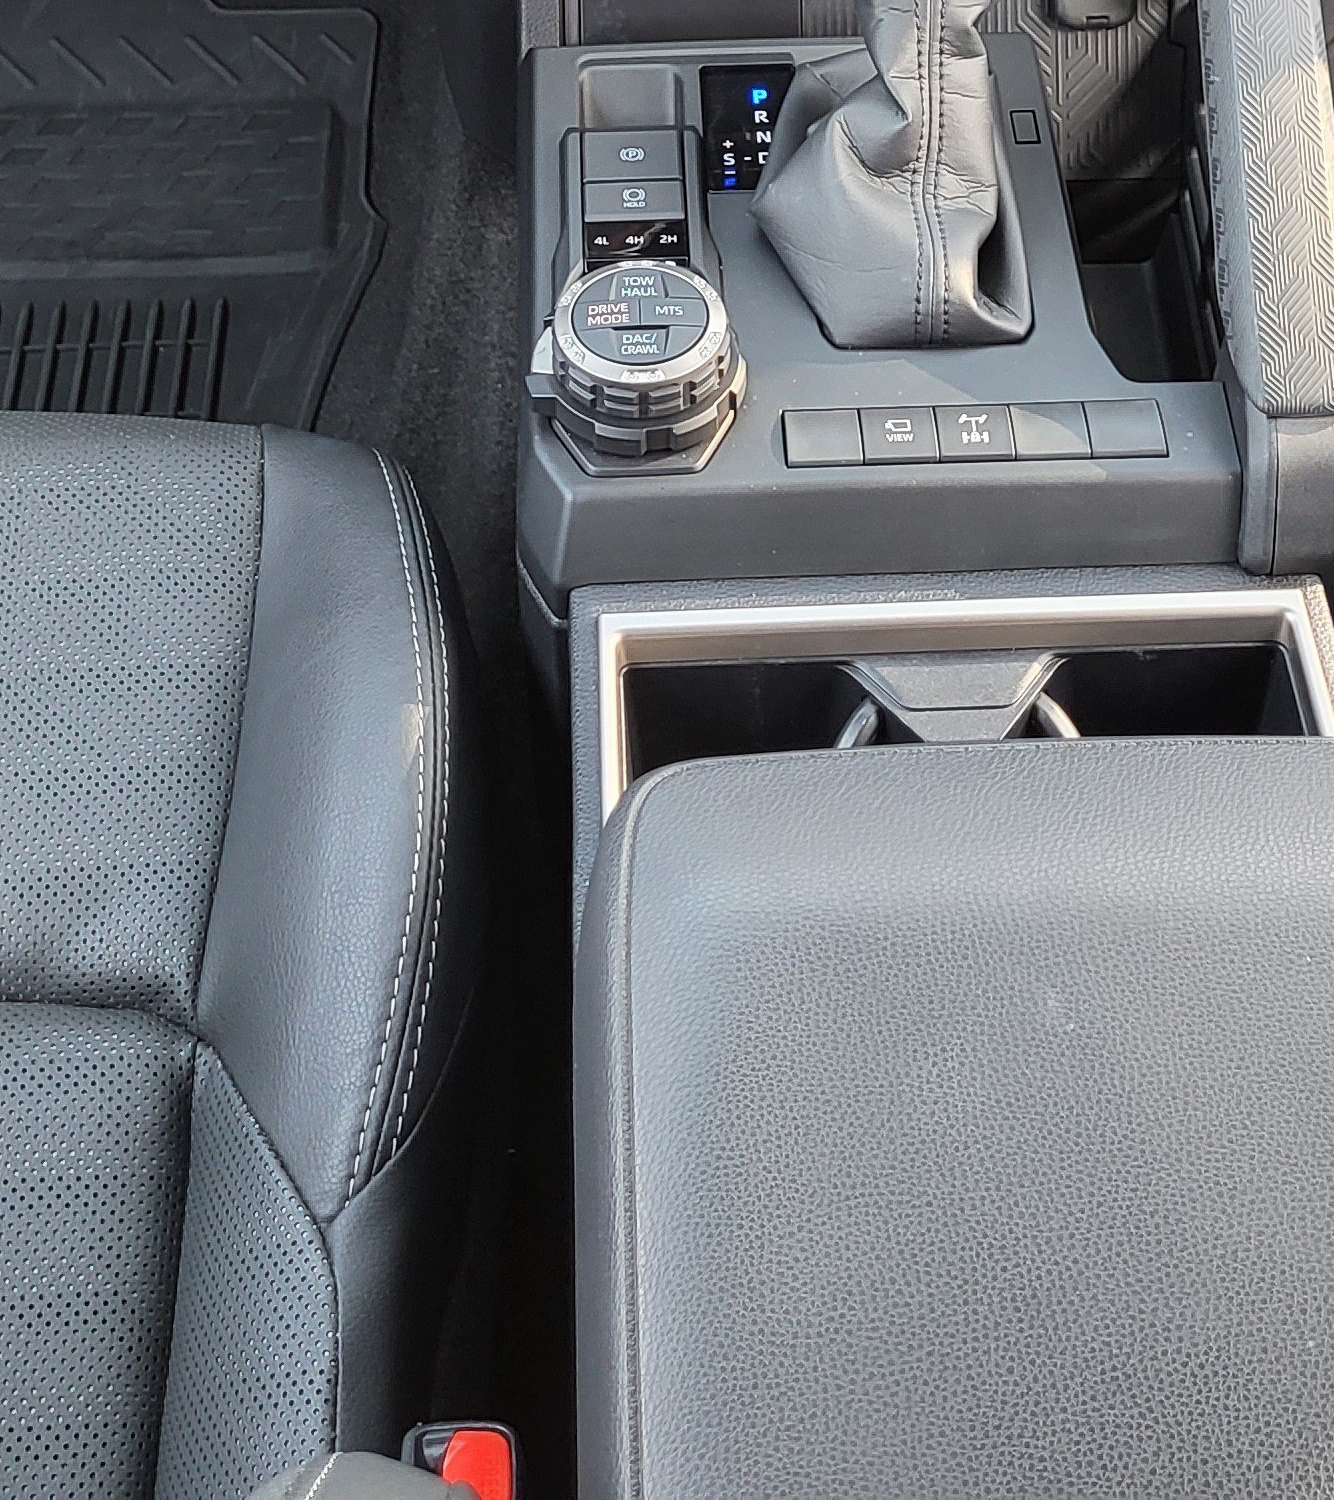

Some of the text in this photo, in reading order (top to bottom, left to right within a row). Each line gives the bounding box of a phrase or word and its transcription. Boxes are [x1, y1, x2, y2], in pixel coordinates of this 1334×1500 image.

[752, 89, 768, 104] P
[754, 110, 769, 124] R
[755, 130, 772, 144] N
[723, 152, 736, 166] S
[593, 236, 610, 246] 4L
[625, 235, 644, 245] 4H
[659, 234, 678, 244] 2H
[622, 276, 655, 286] TOW
[620, 287, 659, 297] HAUL
[588, 302, 629, 316] DRIVE
[655, 305, 684, 316] MTS
[587, 313, 631, 327] MODE
[622, 333, 658, 344] DAC/
[620, 344, 660, 355] CRAWL
[885, 432, 916, 444] VIEW
